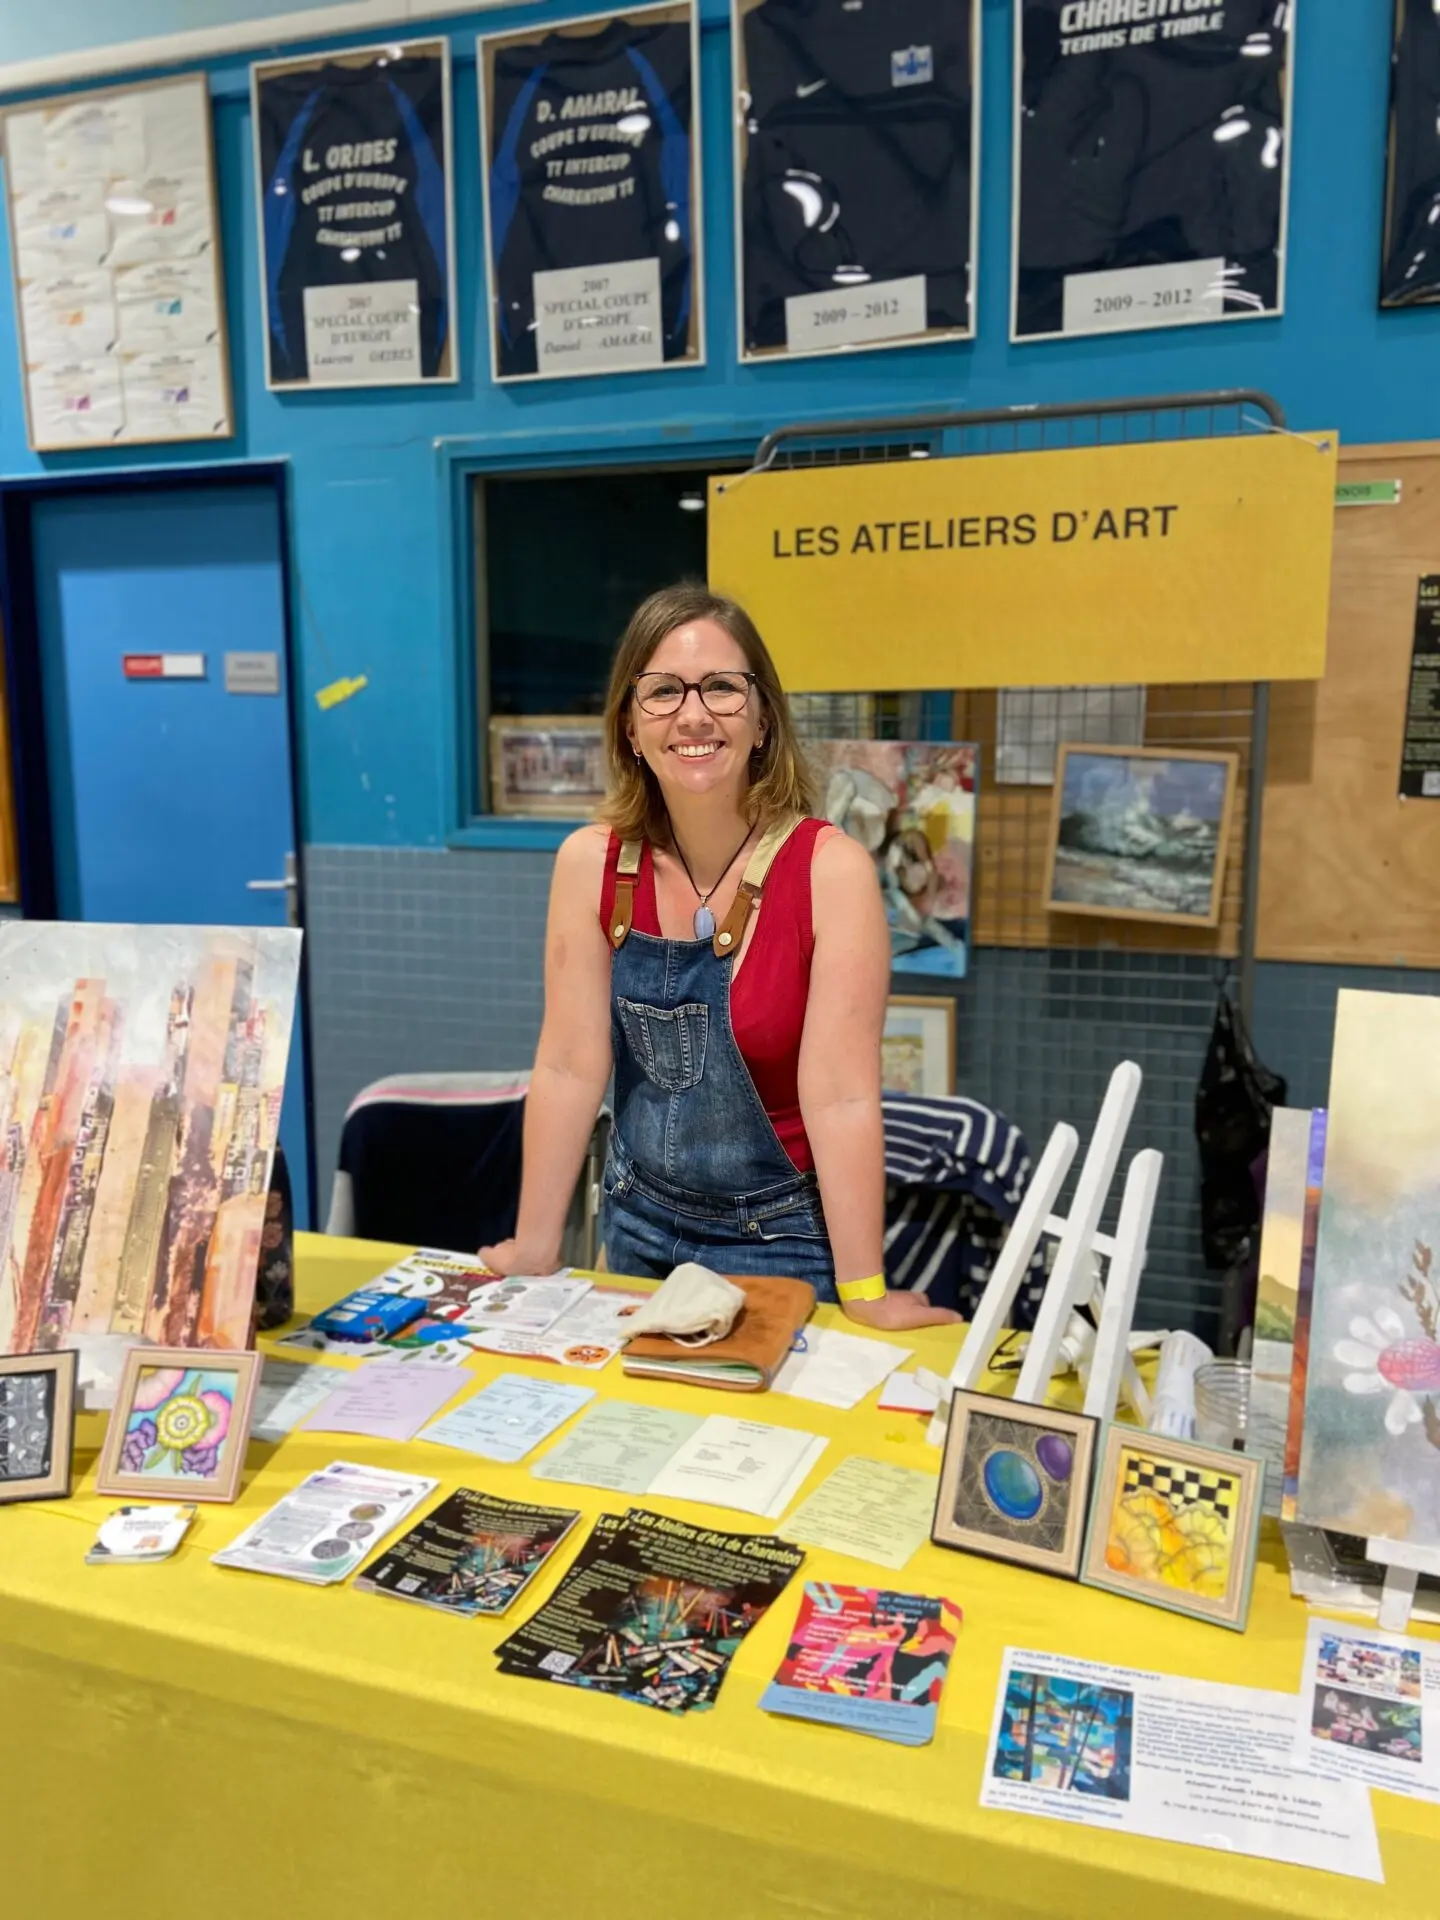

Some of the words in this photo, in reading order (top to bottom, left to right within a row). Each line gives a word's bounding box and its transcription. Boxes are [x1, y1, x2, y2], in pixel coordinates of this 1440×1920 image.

[1060, 0, 1224, 33] CHAREN
[1060, 29, 1127, 55] TENNIS
[1129, 24, 1158, 44] DE
[1161, 11, 1225, 38] TABLE
[537, 100, 556, 122] D.
[560, 87, 644, 120] AMARAL
[325, 138, 398, 170] ORIBES
[530, 127, 575, 158] COUPE
[546, 160, 564, 178] TT
[564, 153, 631, 175] INTERCUP
[302, 175, 342, 205] COUPE
[542, 184, 617, 206] CHARENTON
[618, 177, 635, 198] TT
[317, 205, 335, 222] TT
[335, 199, 396, 220] INTERCUP
[385, 221, 403, 242] TT
[582, 278, 609, 293] 2007
[543, 298, 600, 316] SPECIAL
[603, 292, 650, 310] COUPE
[813, 307, 847, 326] 2009
[864, 298, 899, 319] 2012
[1093, 293, 1133, 314] 2009
[1153, 288, 1192, 307] 2012
[314, 314, 364, 328] SPECIAL
[599, 331, 655, 348] AMARAL
[773, 526, 840, 558] LES
[851, 513, 1037, 554] ATELIERS
[1051, 505, 1178, 542] D'ART
[597, 1516, 619, 1531] Les
[634, 1512, 655, 1526] Les
[653, 1517, 698, 1540] Ateliers
[696, 1531, 727, 1549] d'Art
[725, 1538, 741, 1552] de
[742, 1541, 801, 1567] Charenton
